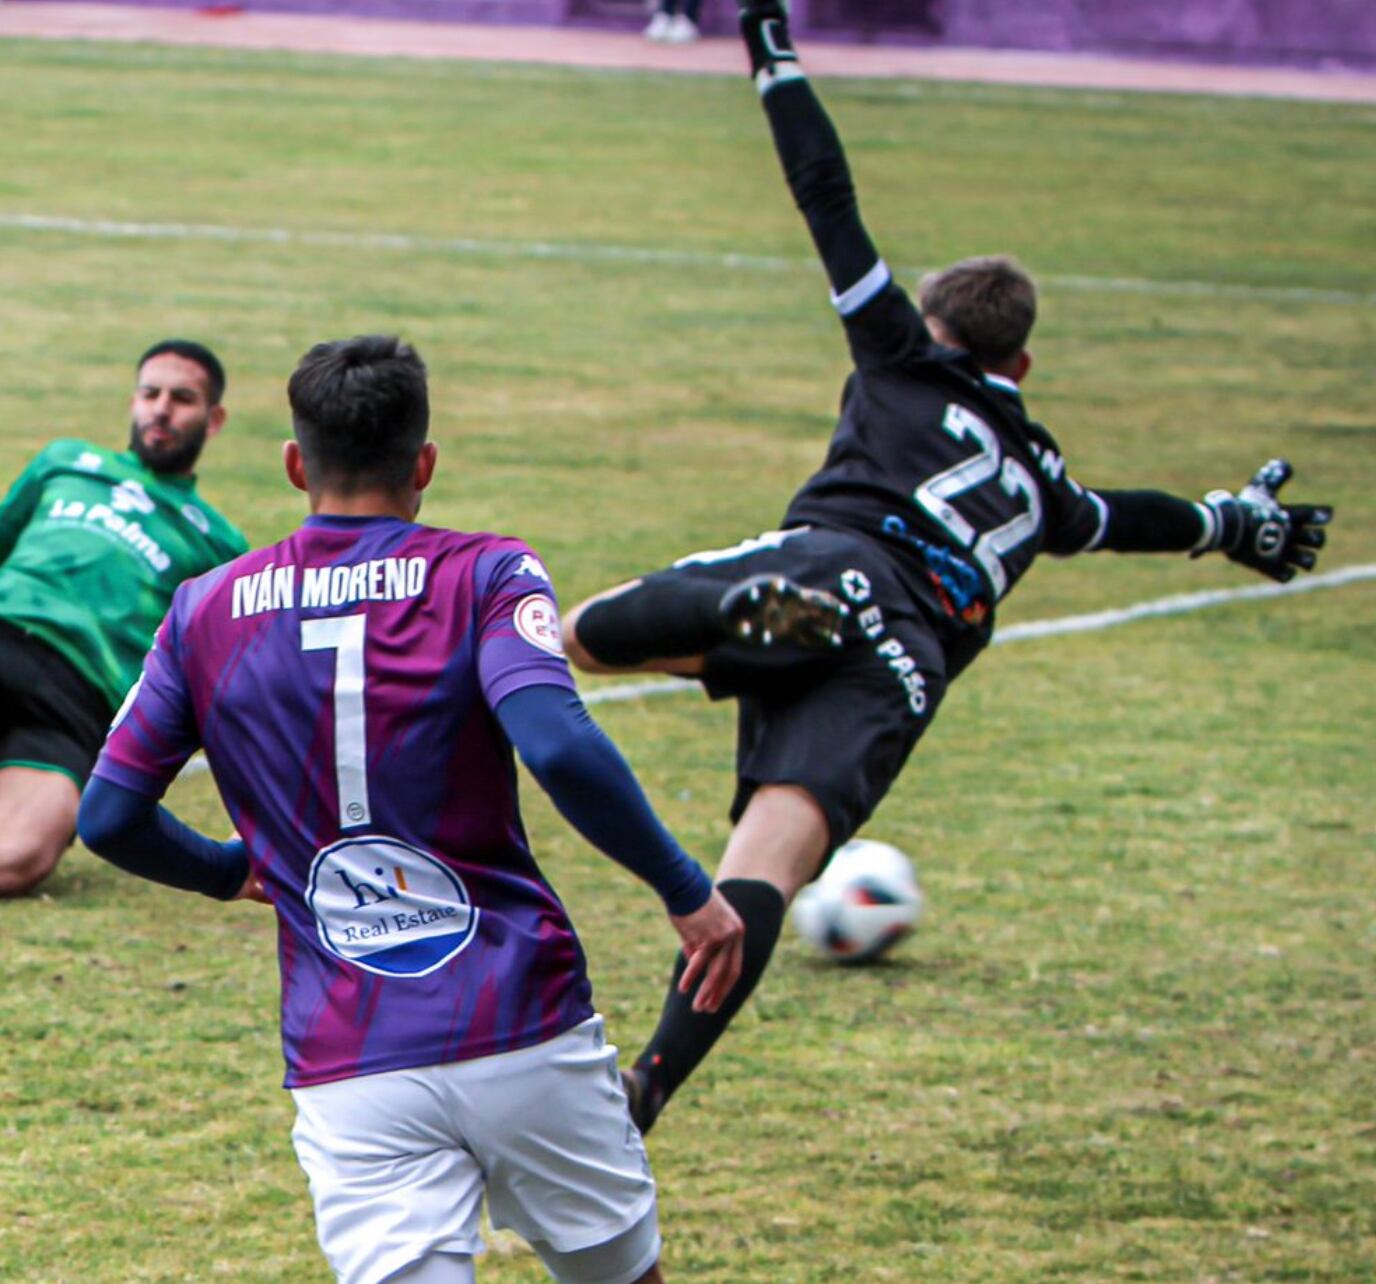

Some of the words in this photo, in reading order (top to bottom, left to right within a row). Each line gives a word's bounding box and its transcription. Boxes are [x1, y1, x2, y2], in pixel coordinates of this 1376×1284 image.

[49, 498, 85, 517] La
[85, 503, 171, 572] Palma
[915, 403, 1042, 600] 22
[232, 562, 295, 619] IVÁN
[301, 557, 427, 608] MORENO
[876, 638, 927, 714] PASO
[300, 613, 371, 829] 7
[343, 917, 389, 942] Real
[393, 906, 457, 931] Estate
